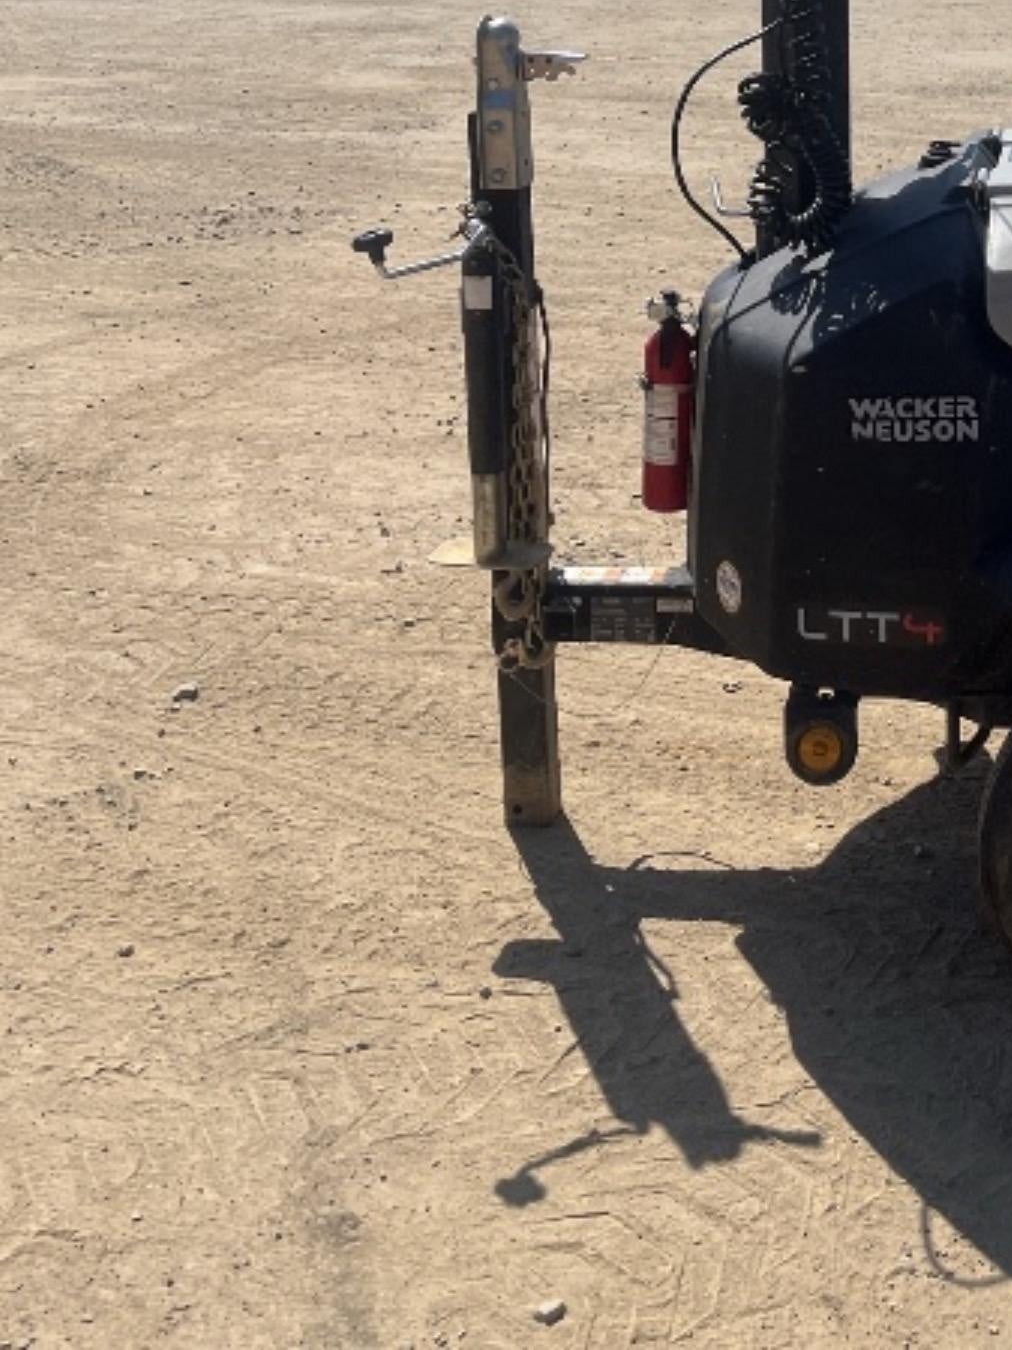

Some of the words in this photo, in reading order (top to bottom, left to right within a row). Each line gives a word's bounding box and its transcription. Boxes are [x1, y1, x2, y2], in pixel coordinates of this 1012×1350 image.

[848, 395, 980, 421] WACKER
[850, 418, 980, 443] NEUSON
[797, 606, 944, 646] LTT4
